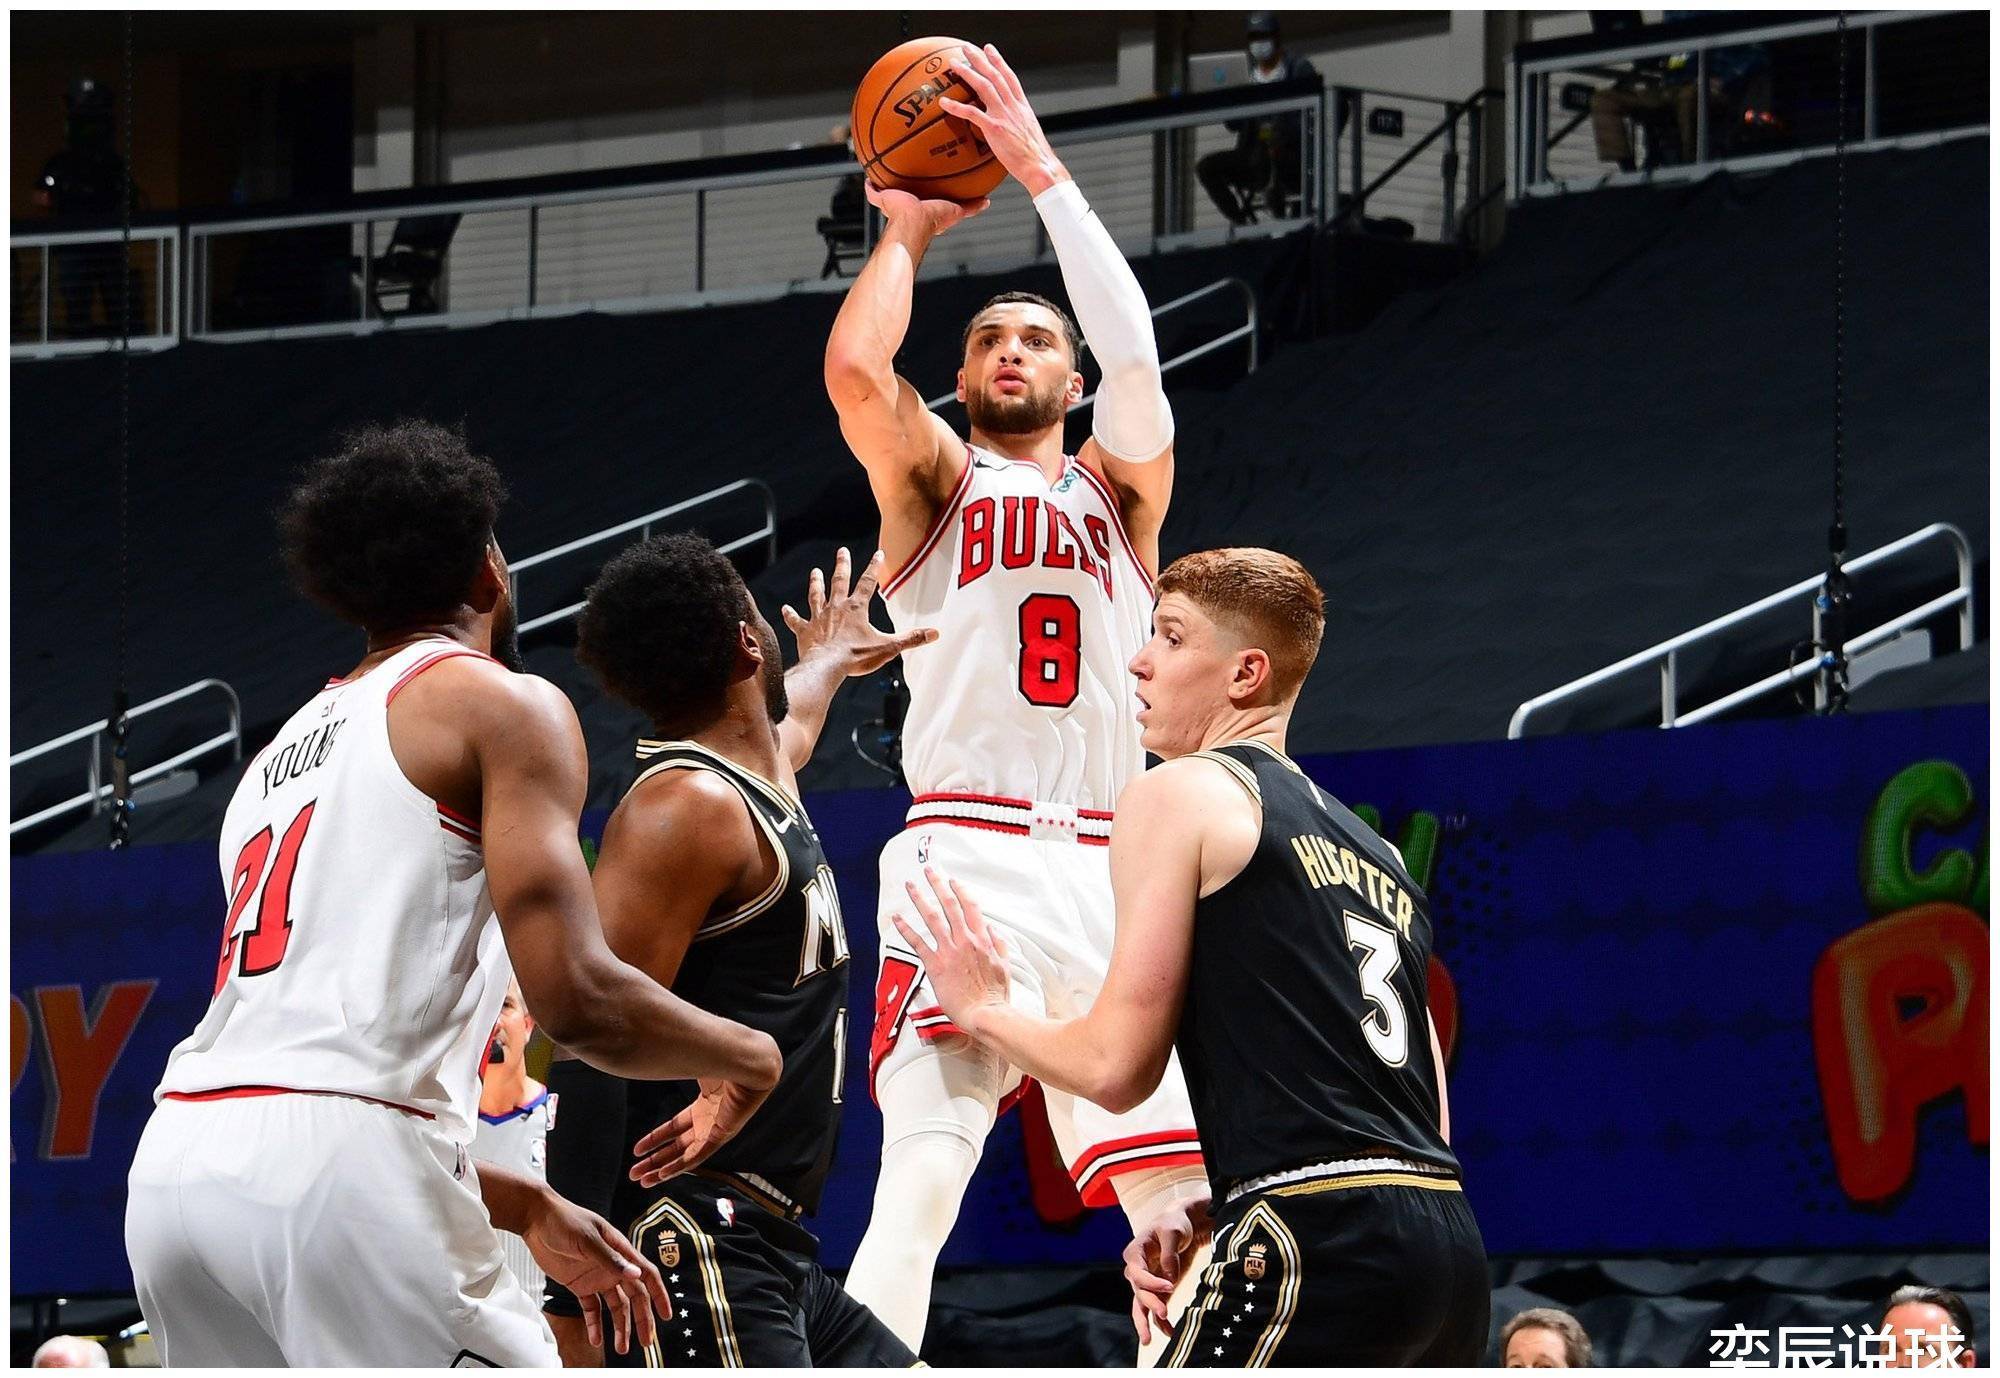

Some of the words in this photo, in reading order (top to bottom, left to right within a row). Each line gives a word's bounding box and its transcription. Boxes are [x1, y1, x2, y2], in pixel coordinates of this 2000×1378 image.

[958, 496, 1113, 604] BULLS
[1018, 593, 1081, 708] 8
[1865, 759, 1990, 912] C
[213, 797, 318, 1004] 21
[1343, 908, 1408, 1068] 3
[661, 1246, 677, 1256] MLK
[1246, 1259, 1264, 1270] MLK
